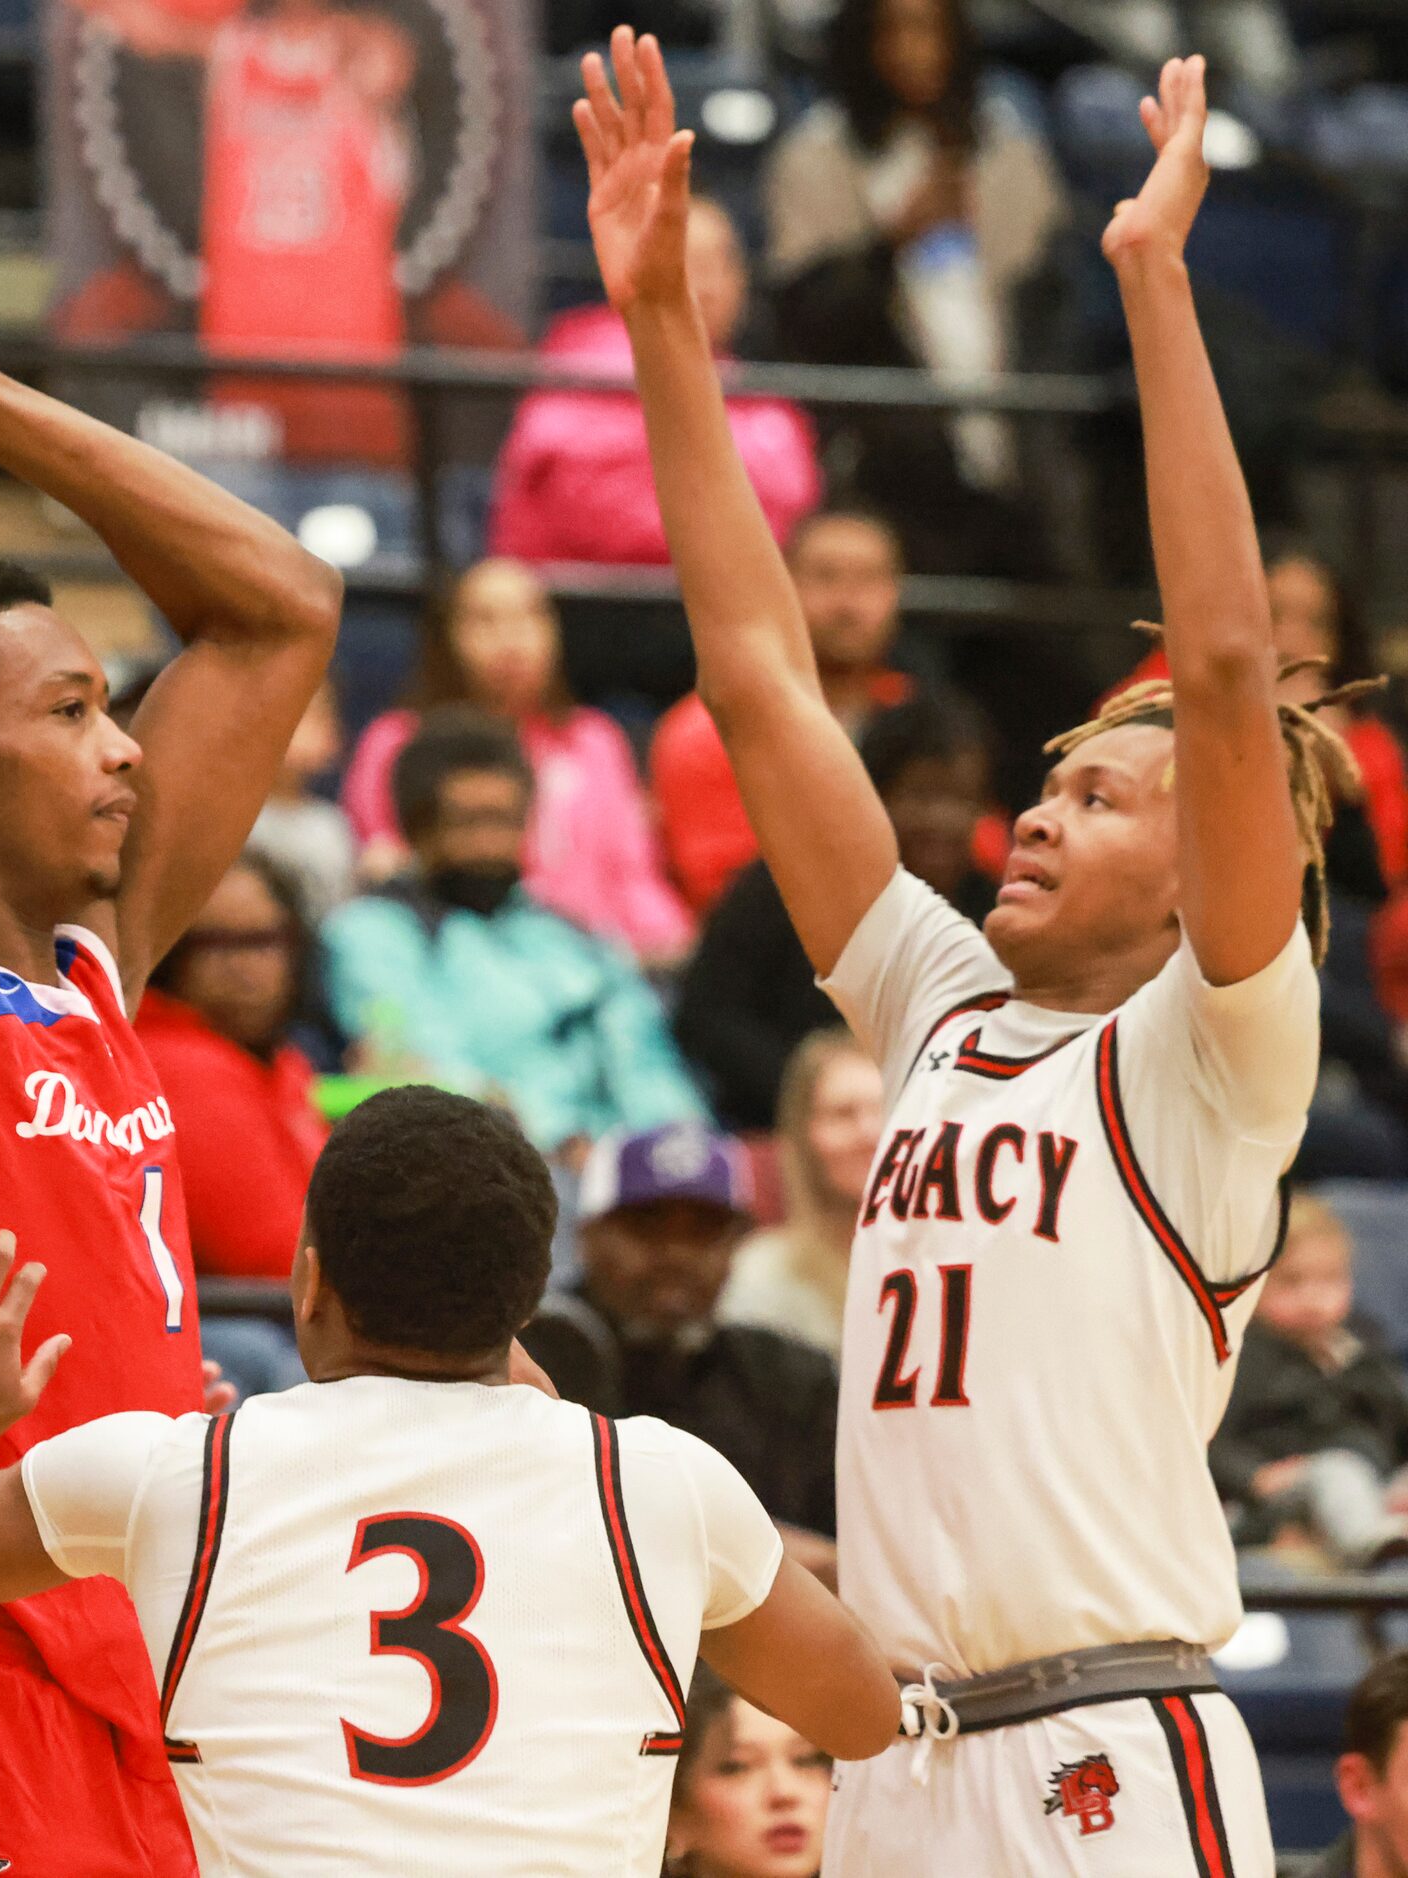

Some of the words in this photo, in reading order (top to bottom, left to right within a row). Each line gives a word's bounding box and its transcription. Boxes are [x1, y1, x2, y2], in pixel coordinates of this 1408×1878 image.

[139, 1165, 185, 1334] 1
[861, 1120, 1078, 1243] EGACY
[871, 1263, 973, 1411] 21
[339, 1510, 500, 1788] 3
